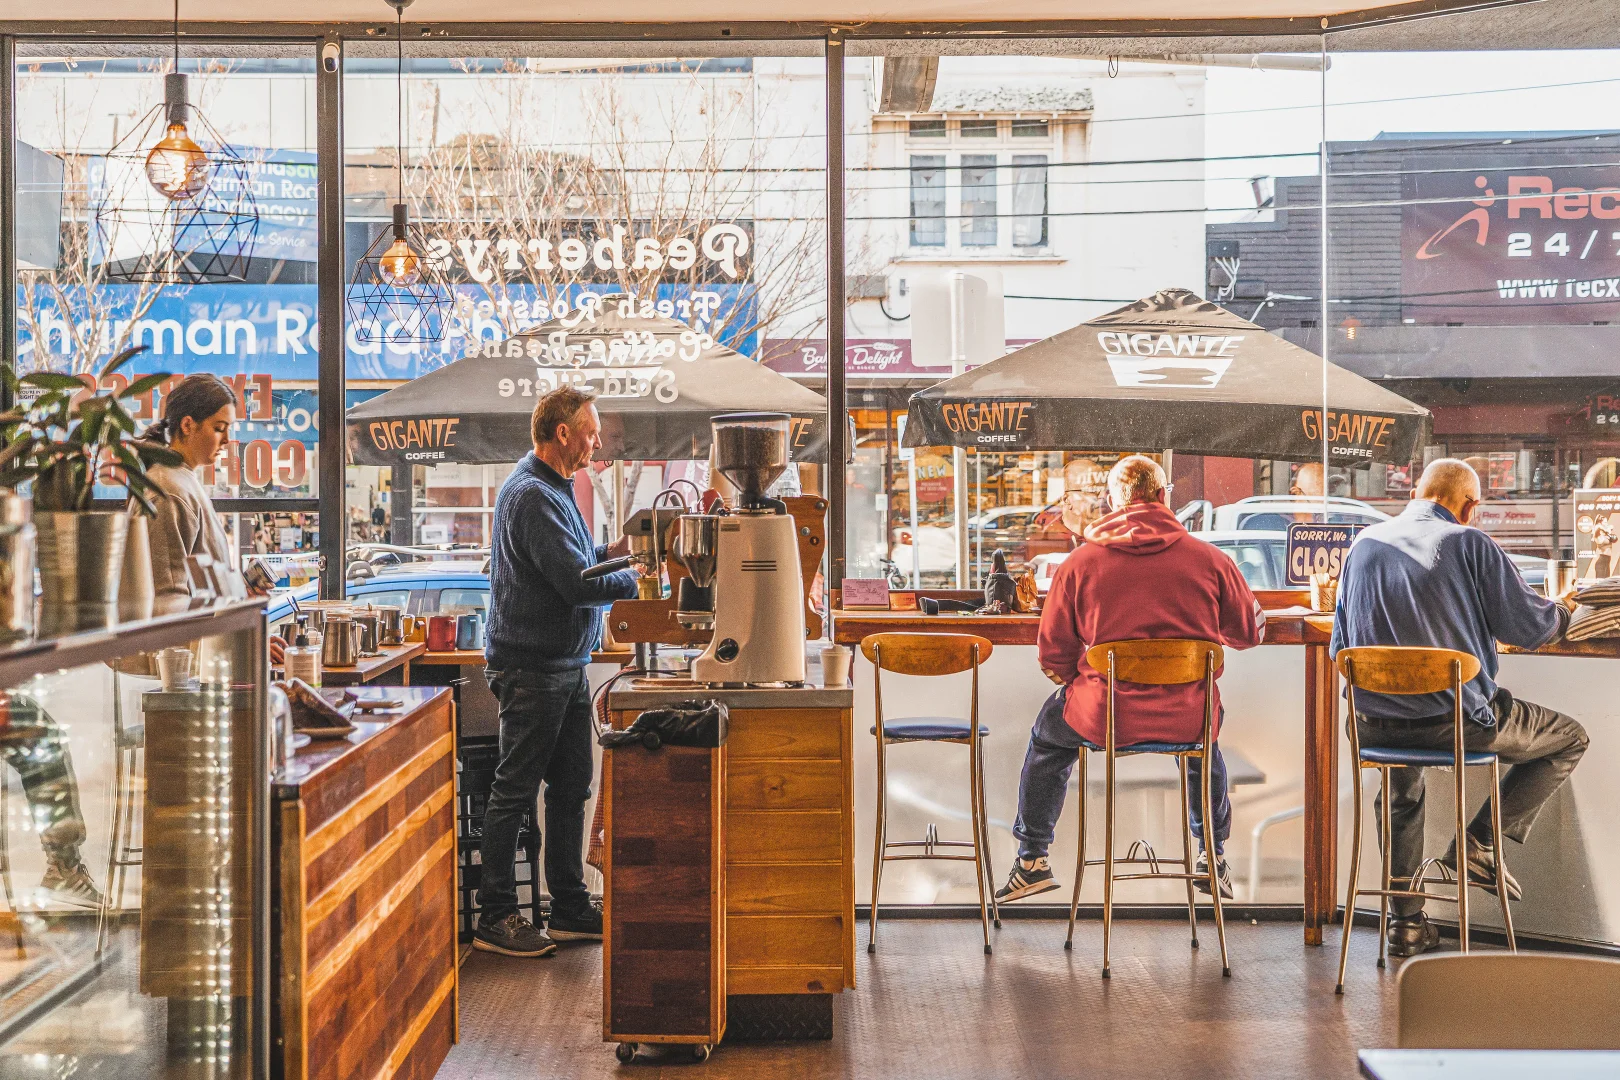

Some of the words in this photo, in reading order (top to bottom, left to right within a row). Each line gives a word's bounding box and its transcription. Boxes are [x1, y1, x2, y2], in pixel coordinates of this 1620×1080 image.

[277, 309, 421, 355] Rad
[1097, 332, 1246, 357] GIGANTE
[853, 347, 903, 370] Delight
[942, 402, 1032, 433] GIGANTE
[1301, 410, 1396, 447] GIGANTE
[370, 418, 460, 451] GIGANTE
[977, 434, 1017, 443] COFFEE
[405, 451, 446, 461] COFFEE
[1331, 446, 1373, 458] COFFEE
[917, 464, 946, 480] NEW
[1294, 530, 1332, 542] SORRY,
[1333, 531, 1347, 541] We
